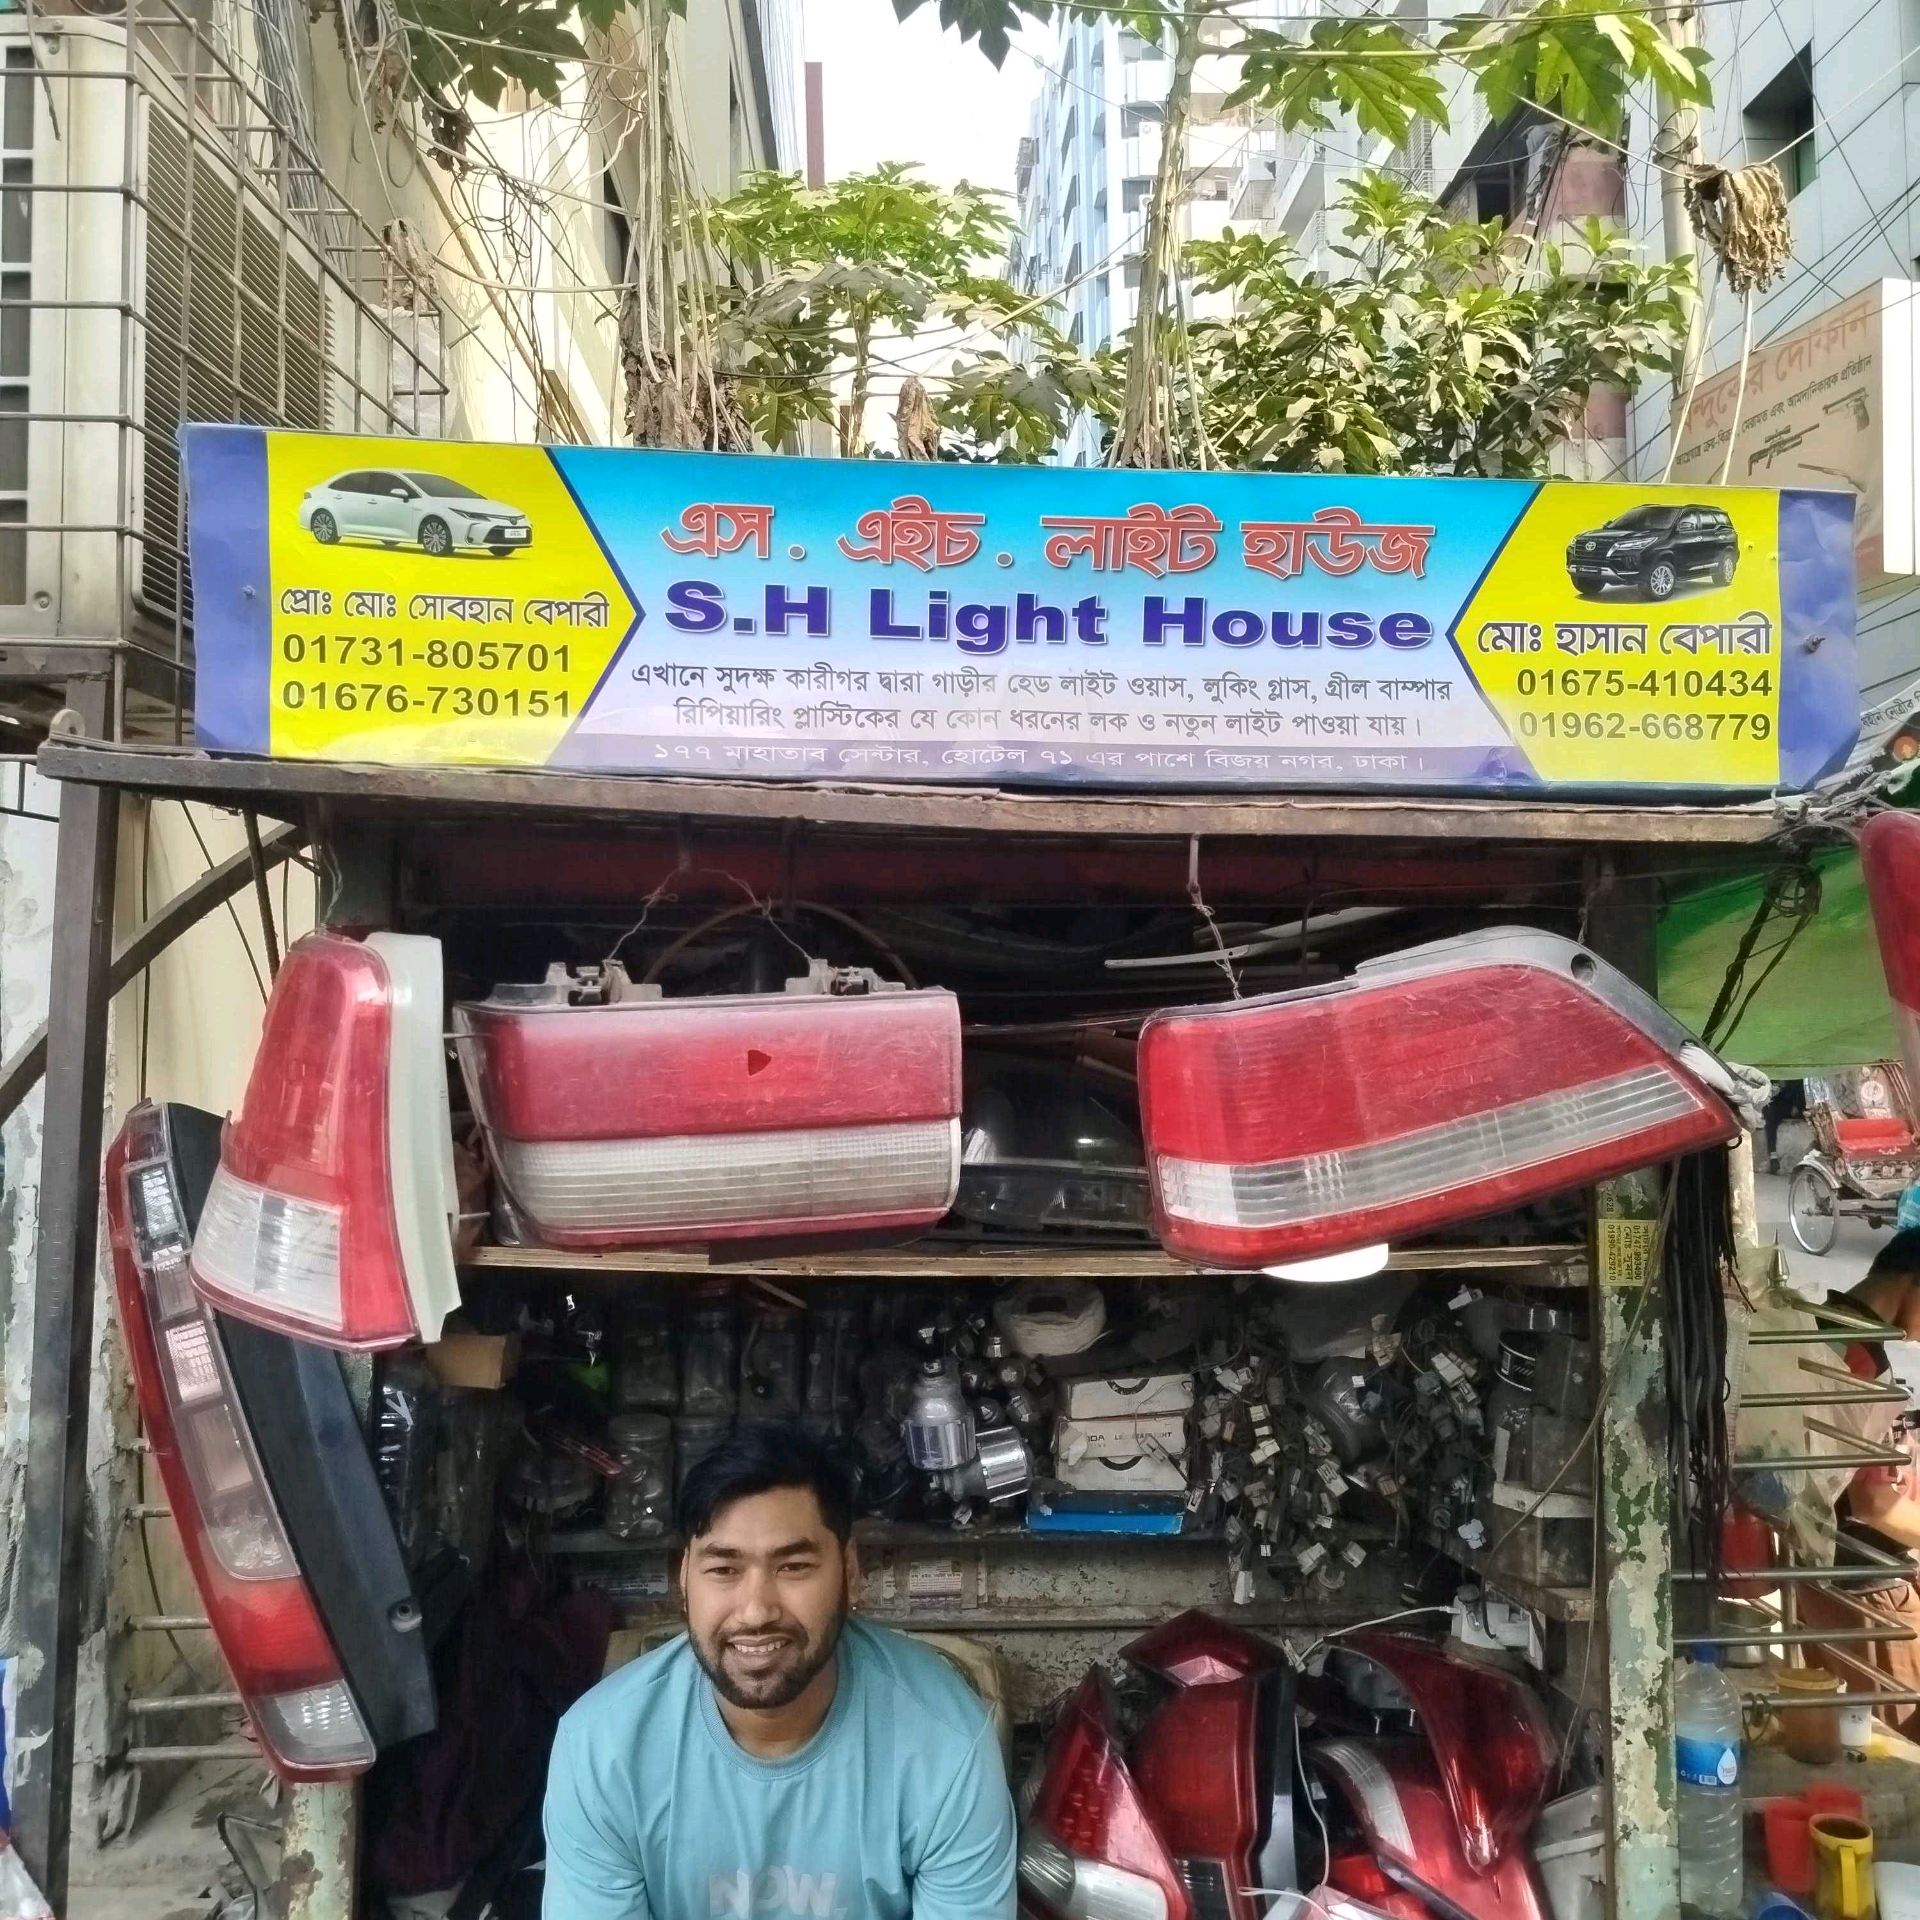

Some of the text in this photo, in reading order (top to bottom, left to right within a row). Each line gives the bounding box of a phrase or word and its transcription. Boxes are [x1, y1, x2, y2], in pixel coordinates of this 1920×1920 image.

[1040, 502, 1223, 578] লাইট
[1240, 506, 1436, 579] হাউজ
[280, 588, 610, 628] প্রোঃ মোঃ সোবহান বেপারী
[664, 580, 1434, 655] S.H Light House
[282, 633, 570, 673] 01731-805701
[1478, 610, 1774, 657] মোঃ হাসান বেপারী
[282, 680, 570, 719] 01676-730151
[632, 662, 708, 688] এখানে
[713, 667, 777, 694] সুদক্ষ
[783, 661, 870, 692] কারীগর
[877, 670, 924, 693] দ্বারা
[931, 666, 998, 698] গাড়ীর
[1007, 674, 1052, 696] হেড
[1058, 668, 1118, 698] লাইট
[1202, 671, 1261, 704] লুকিং
[1324, 671, 1370, 700] গ্রীল
[1376, 678, 1454, 701] বাম্পার
[1517, 668, 1773, 698] 01675-410434
[673, 696, 785, 728] রিপিয়ারিং
[793, 700, 901, 730] প্লাস্টিকের
[910, 709, 938, 729] যে
[946, 707, 1001, 730] কোন
[1009, 709, 1082, 732] ধরনের
[1088, 713, 1129, 732] লক
[1137, 714, 1155, 731] ও
[1162, 713, 1218, 740] নতুন
[1223, 708, 1283, 737] লাইট
[1291, 714, 1360, 737] পাওয়া
[1519, 712, 1771, 741] 01962-668779
[654, 743, 712, 760] ১৭৭
[941, 745, 1028, 766] হোটেল
[1040, 749, 1073, 765] ৭১
[1085, 751, 1125, 767] এর
[1134, 752, 1194, 768] পাশে
[1204, 749, 1271, 769] বিজয়
[1351, 753, 1408, 771] ঢাকা
